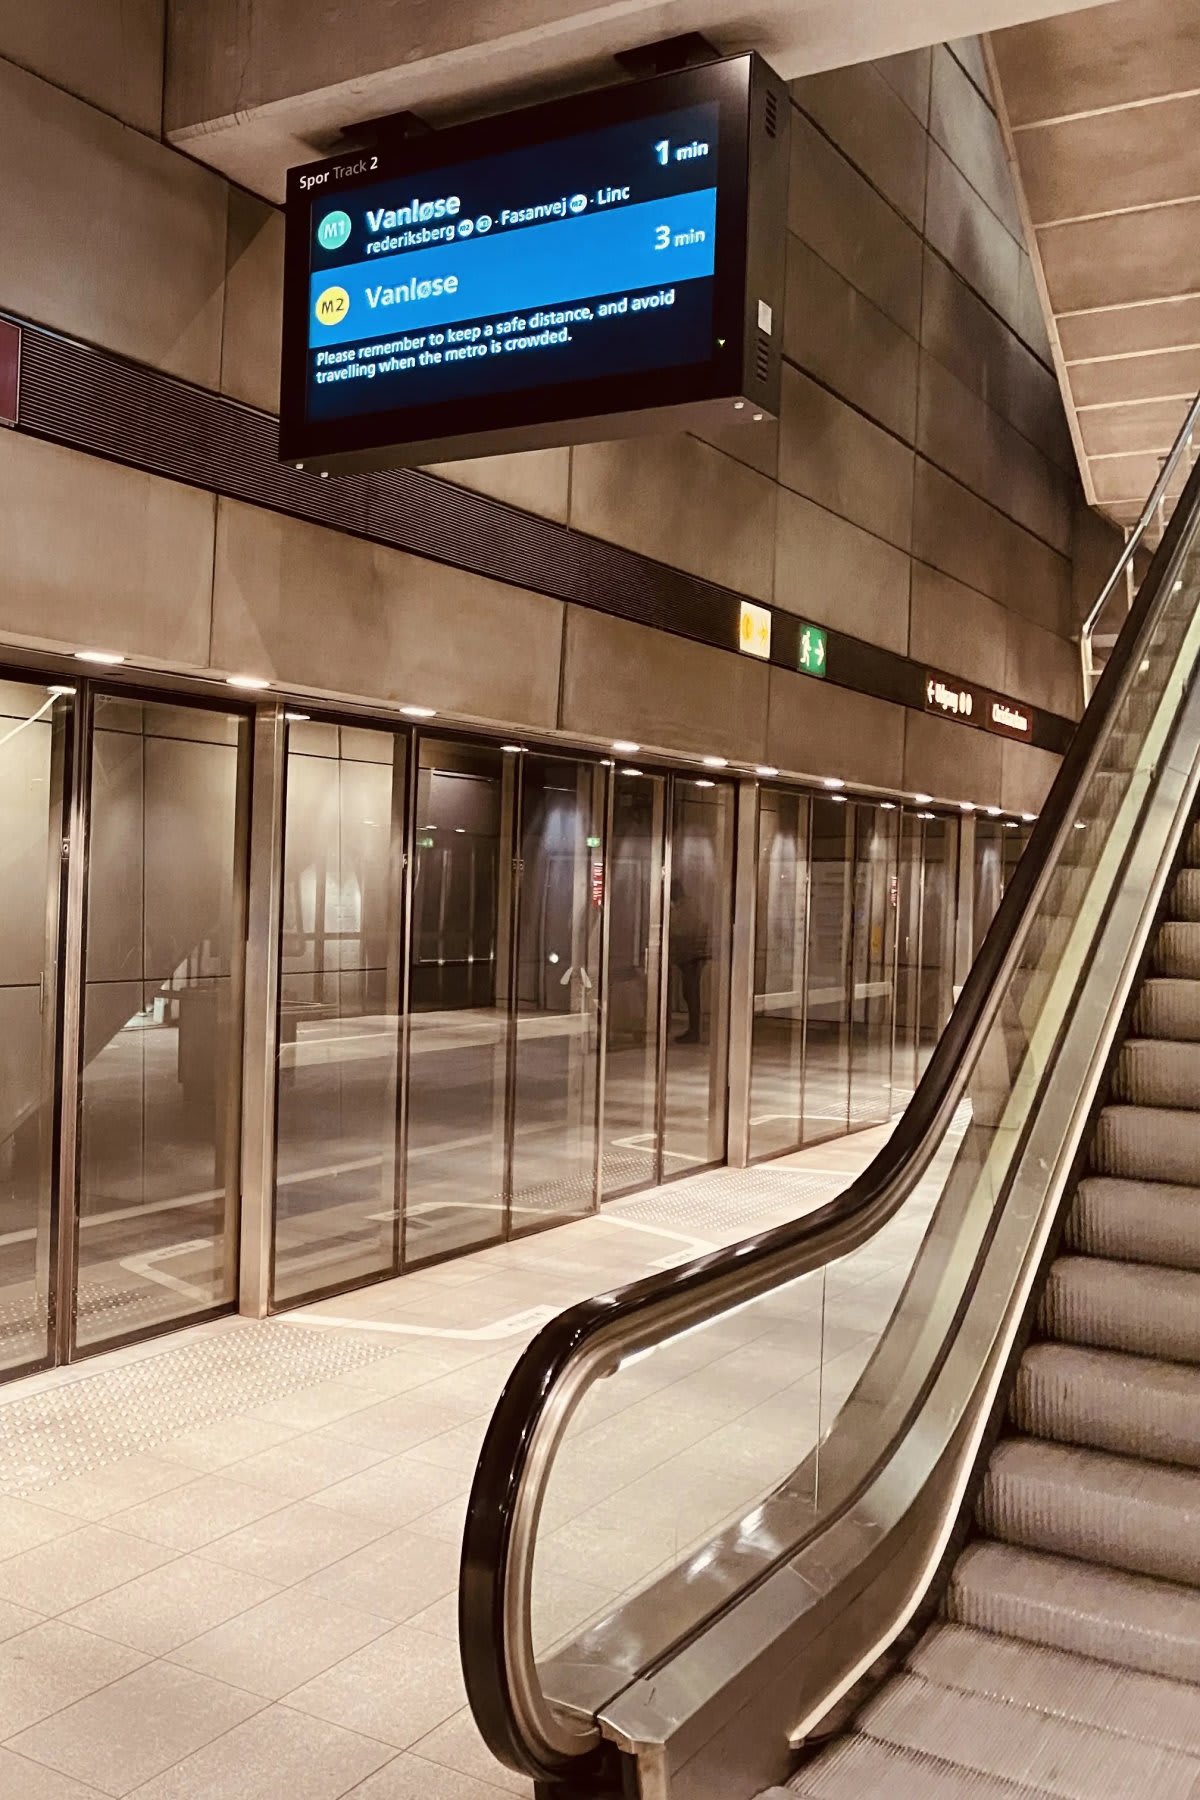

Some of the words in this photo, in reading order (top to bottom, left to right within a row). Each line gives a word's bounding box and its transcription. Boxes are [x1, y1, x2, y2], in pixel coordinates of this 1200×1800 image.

[656, 139, 670, 166] 1
[676, 141, 709, 161] min
[299, 171, 330, 190] Spor
[333, 159, 367, 179] Track
[370, 156, 378, 170] 2
[323, 219, 347, 240] M1
[366, 195, 461, 233] Vanløse
[366, 223, 456, 255] rederiksberg
[501, 197, 567, 226] Fasanvej
[654, 225, 671, 250] 3
[674, 228, 706, 247] min
[321, 297, 345, 316] M2
[365, 274, 459, 309] Vanløse
[316, 348, 356, 367] Please
[358, 336, 427, 360] remember
[429, 333, 445, 347] to
[447, 327, 482, 343] keep
[483, 323, 494, 337] a
[496, 316, 526, 335] safe
[529, 306, 595, 330] distance,
[599, 297, 628, 317] and
[631, 288, 676, 311] avoid
[316, 361, 376, 384] travelling
[379, 356, 416, 374] when
[419, 348, 442, 366] the
[445, 343, 488, 362] metro
[491, 338, 502, 354] is
[504, 326, 573, 352] crowded.
